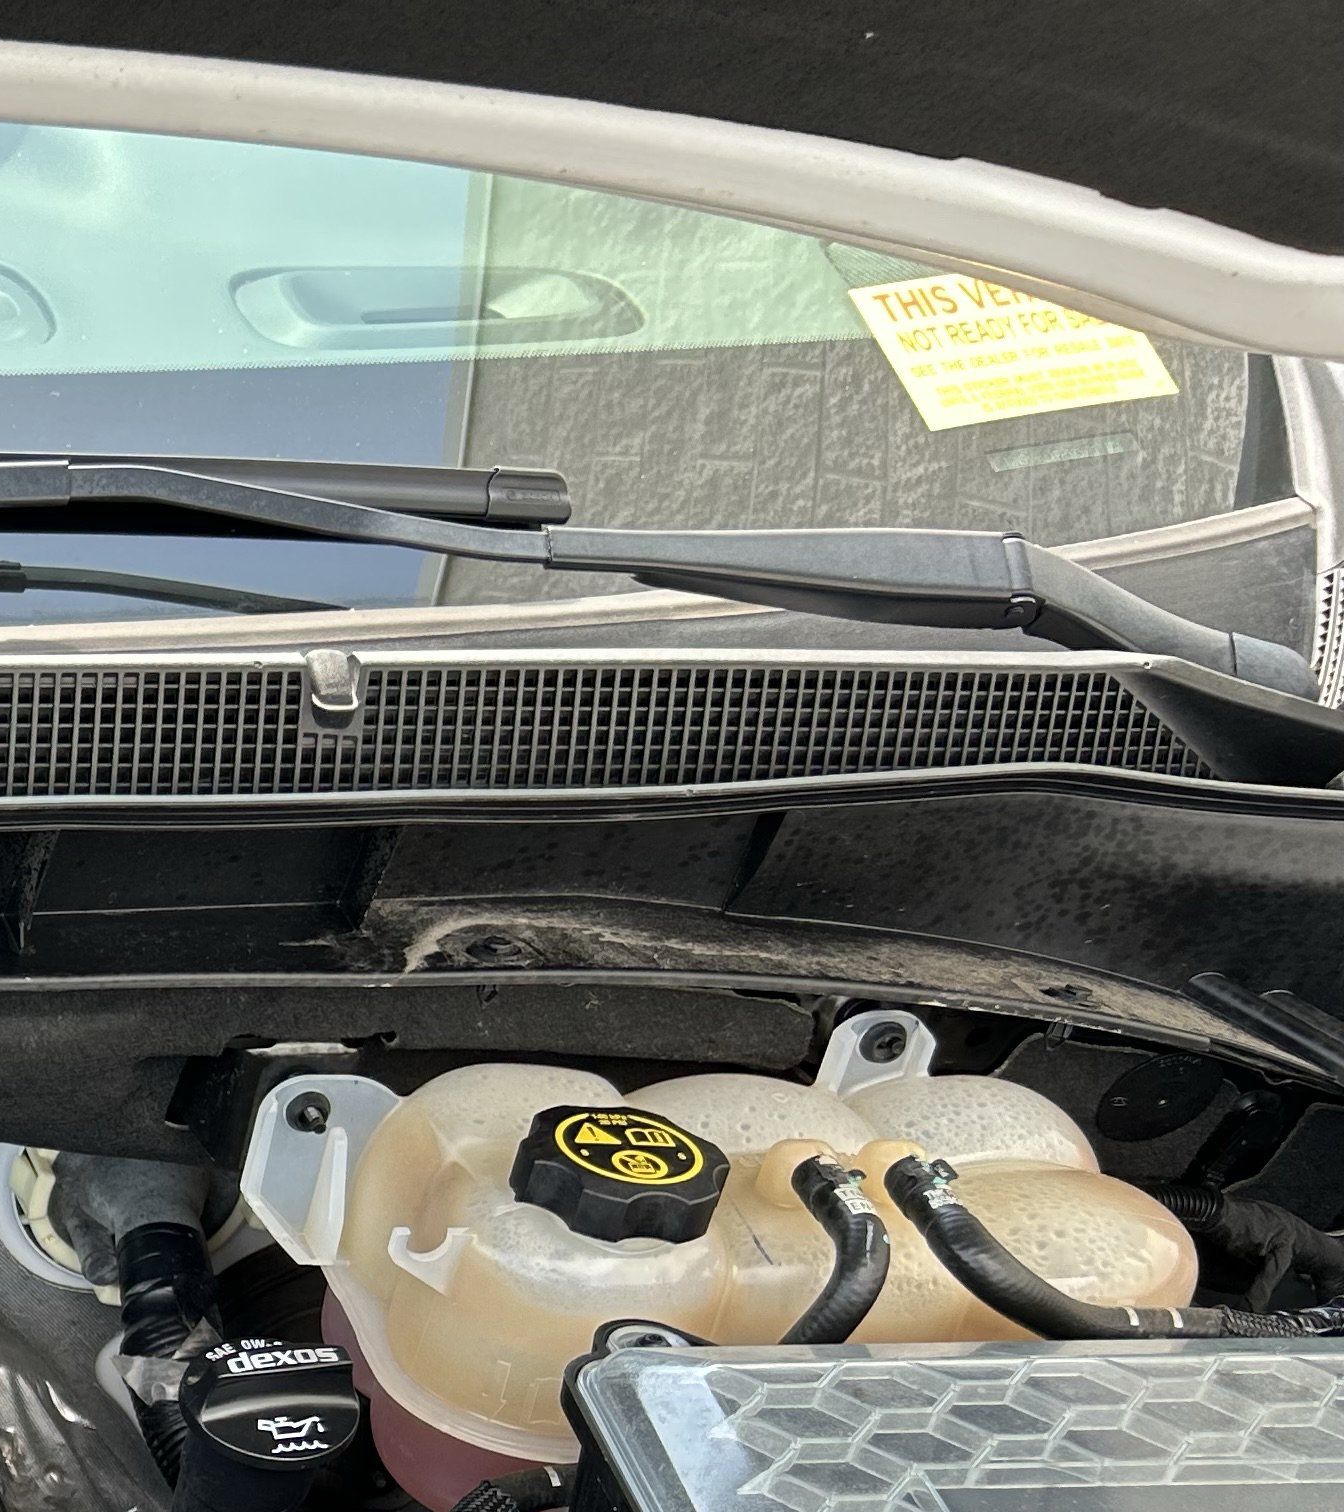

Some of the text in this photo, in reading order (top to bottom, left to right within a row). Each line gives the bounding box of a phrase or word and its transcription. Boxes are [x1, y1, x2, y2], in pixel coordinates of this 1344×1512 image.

[872, 286, 958, 322] THIS
[896, 327, 944, 352] NOT
[945, 316, 1017, 344] READY
[1017, 310, 1064, 335] FOR
[205, 1343, 236, 1362] SAE
[227, 1348, 339, 1373] dexos
